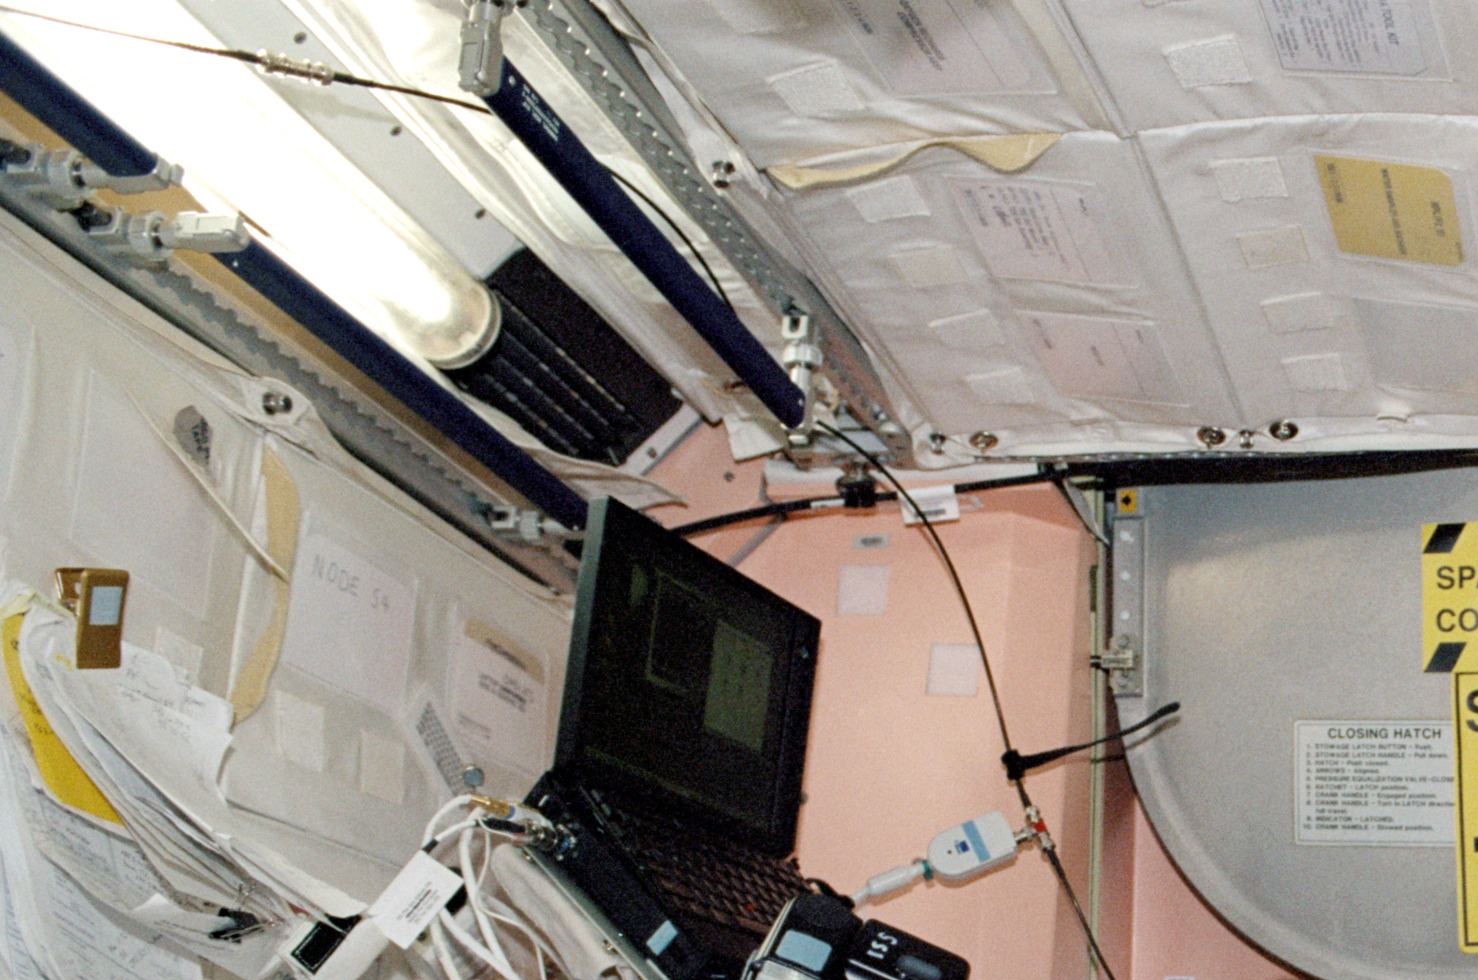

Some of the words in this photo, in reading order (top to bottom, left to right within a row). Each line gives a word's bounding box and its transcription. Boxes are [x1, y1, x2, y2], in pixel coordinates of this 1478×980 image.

[312, 555, 360, 597] NODE
[1327, 728, 1388, 739] CLOSING
[1393, 728, 1441, 739] HATCH
[867, 932, 898, 960] ISS
